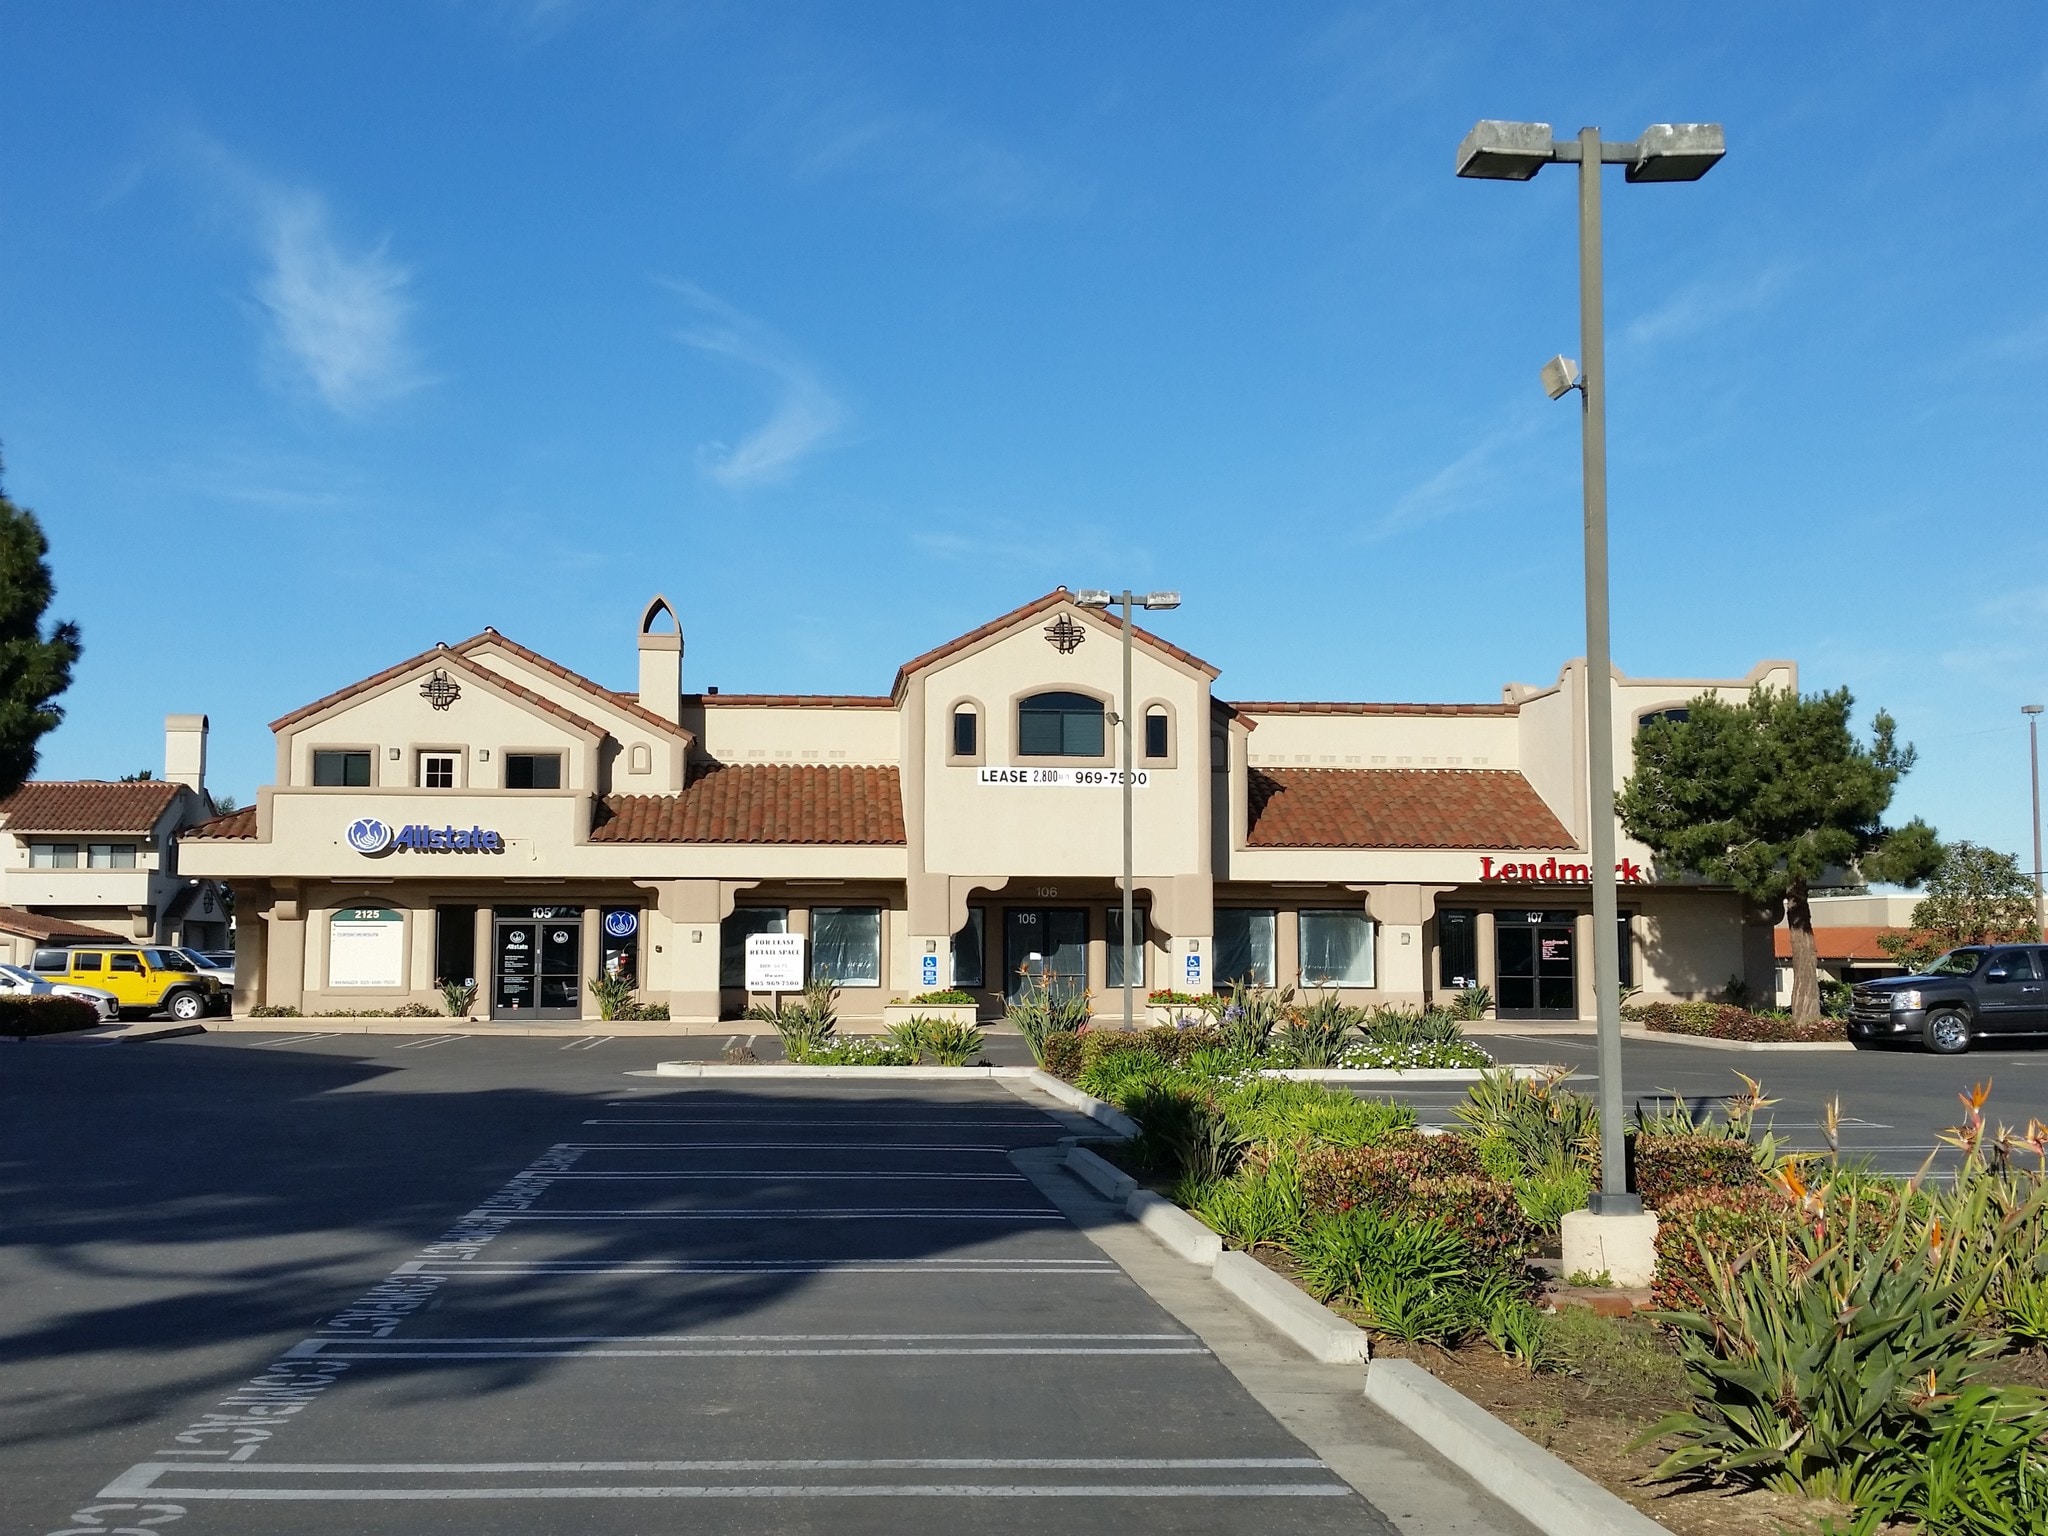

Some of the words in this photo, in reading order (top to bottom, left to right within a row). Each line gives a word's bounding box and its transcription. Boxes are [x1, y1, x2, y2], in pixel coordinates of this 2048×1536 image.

[981, 769, 1028, 783] LEASE
[1075, 771, 1147, 785] 969-7500
[391, 825, 499, 850] Allstate
[1480, 856, 1641, 881] Lendmk
[1036, 886, 1058, 898] 106
[354, 910, 380, 919] 2125
[531, 907, 552, 919] 105
[1017, 913, 1037, 925] 106
[1526, 912, 1544, 923] 107
